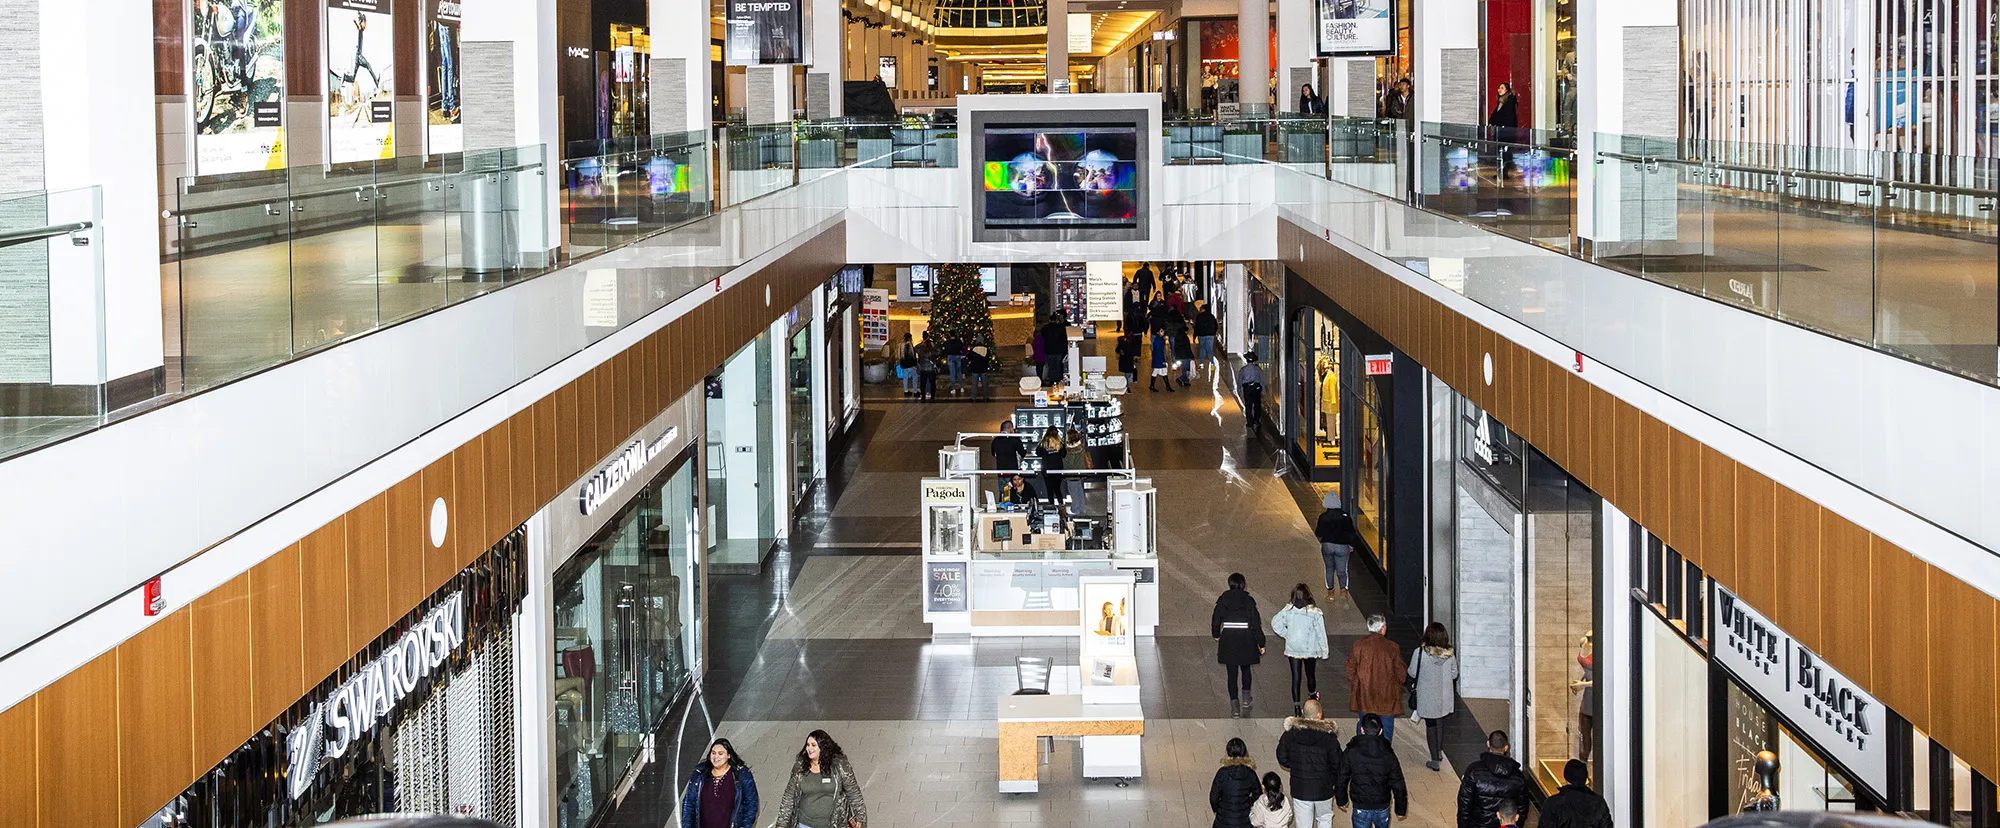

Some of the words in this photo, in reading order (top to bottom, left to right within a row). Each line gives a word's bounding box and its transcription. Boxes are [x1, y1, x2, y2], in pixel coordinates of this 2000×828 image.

[735, 3, 746, 12] BE
[748, 2, 791, 12] TEMPTED
[1370, 360, 1388, 373] EXIT
[1474, 438, 1492, 465] adidas
[580, 438, 648, 516] CALZEDONIA
[926, 487, 965, 500] Pagoda
[933, 572, 961, 581] SALE
[934, 583, 961, 597] 40%
[1718, 587, 1778, 664] WHITE
[1797, 646, 1872, 735] BLACK
[326, 591, 463, 759] SWAROVSKI
[1728, 634, 1770, 676] HOUSE
[1804, 694, 1865, 751] MARKET
[1735, 717, 1766, 751] BLACK
